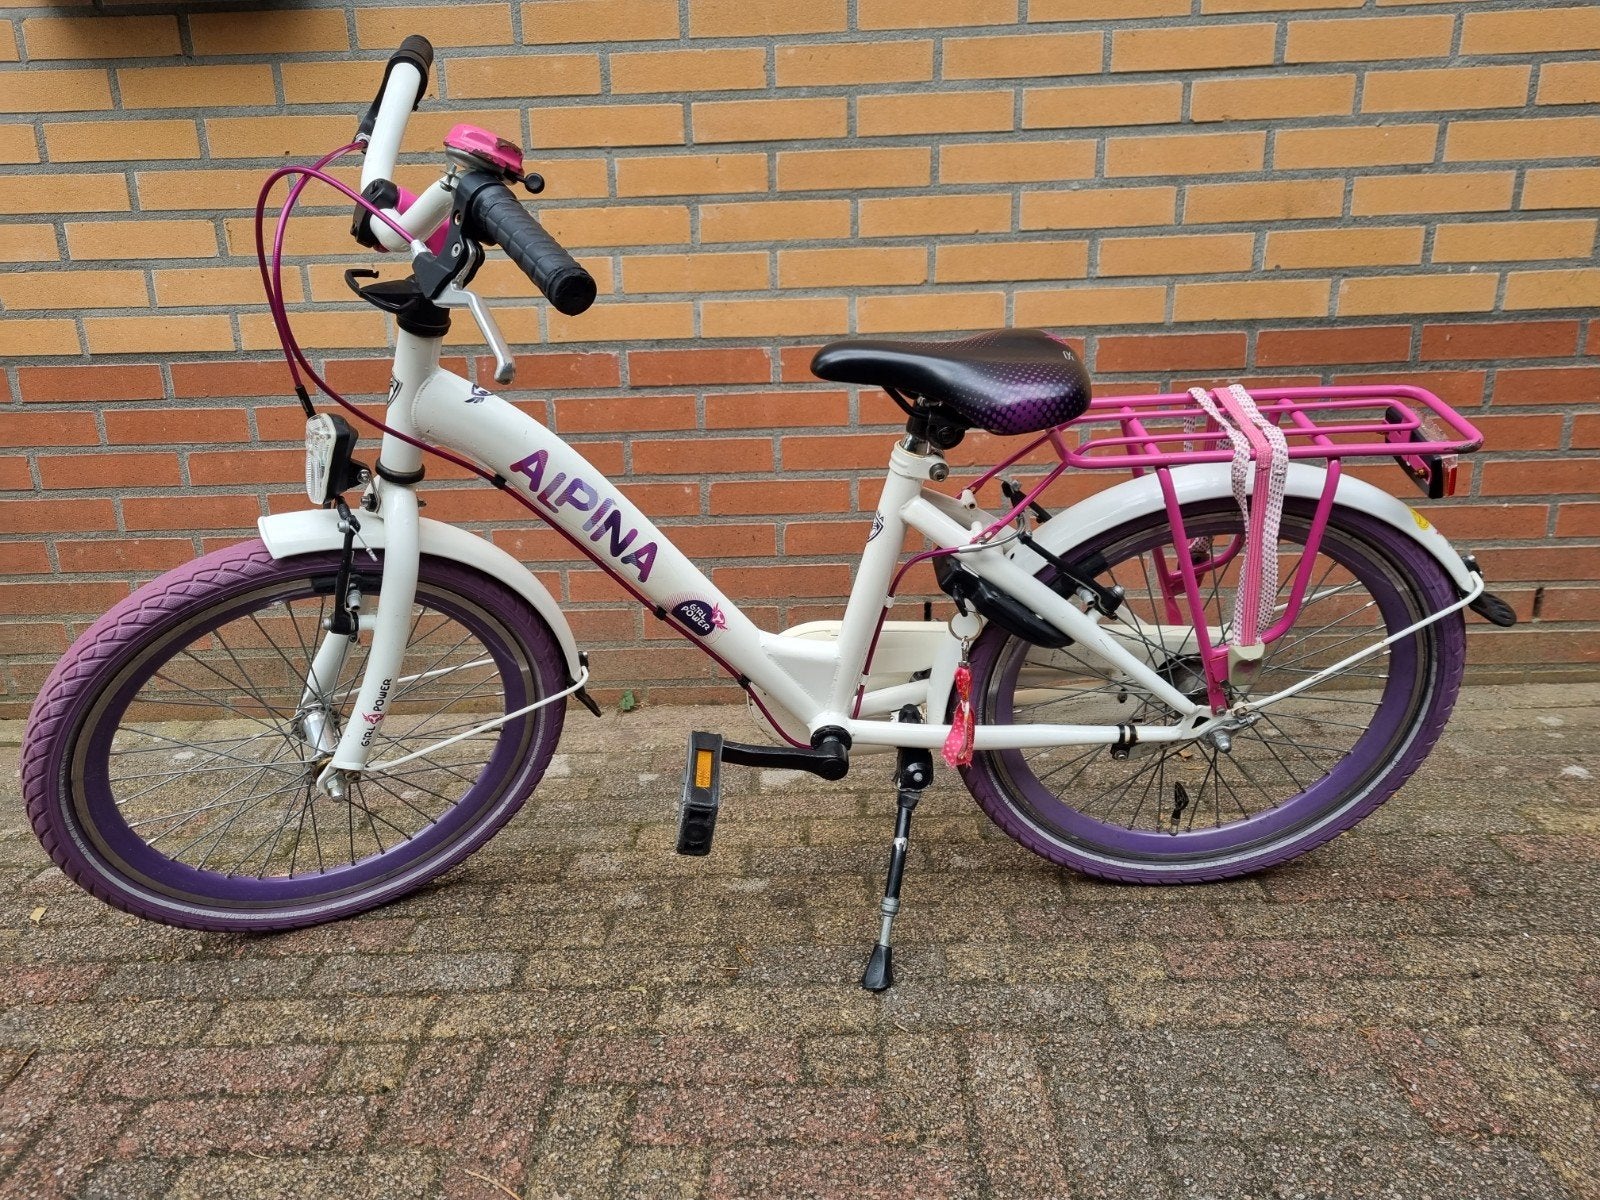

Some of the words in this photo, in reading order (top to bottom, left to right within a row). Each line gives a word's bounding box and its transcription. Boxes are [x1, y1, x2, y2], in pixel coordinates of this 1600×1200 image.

[510, 449, 658, 583] ALPINA
[681, 605, 710, 631] POWER
[373, 678, 392, 711] POWER
